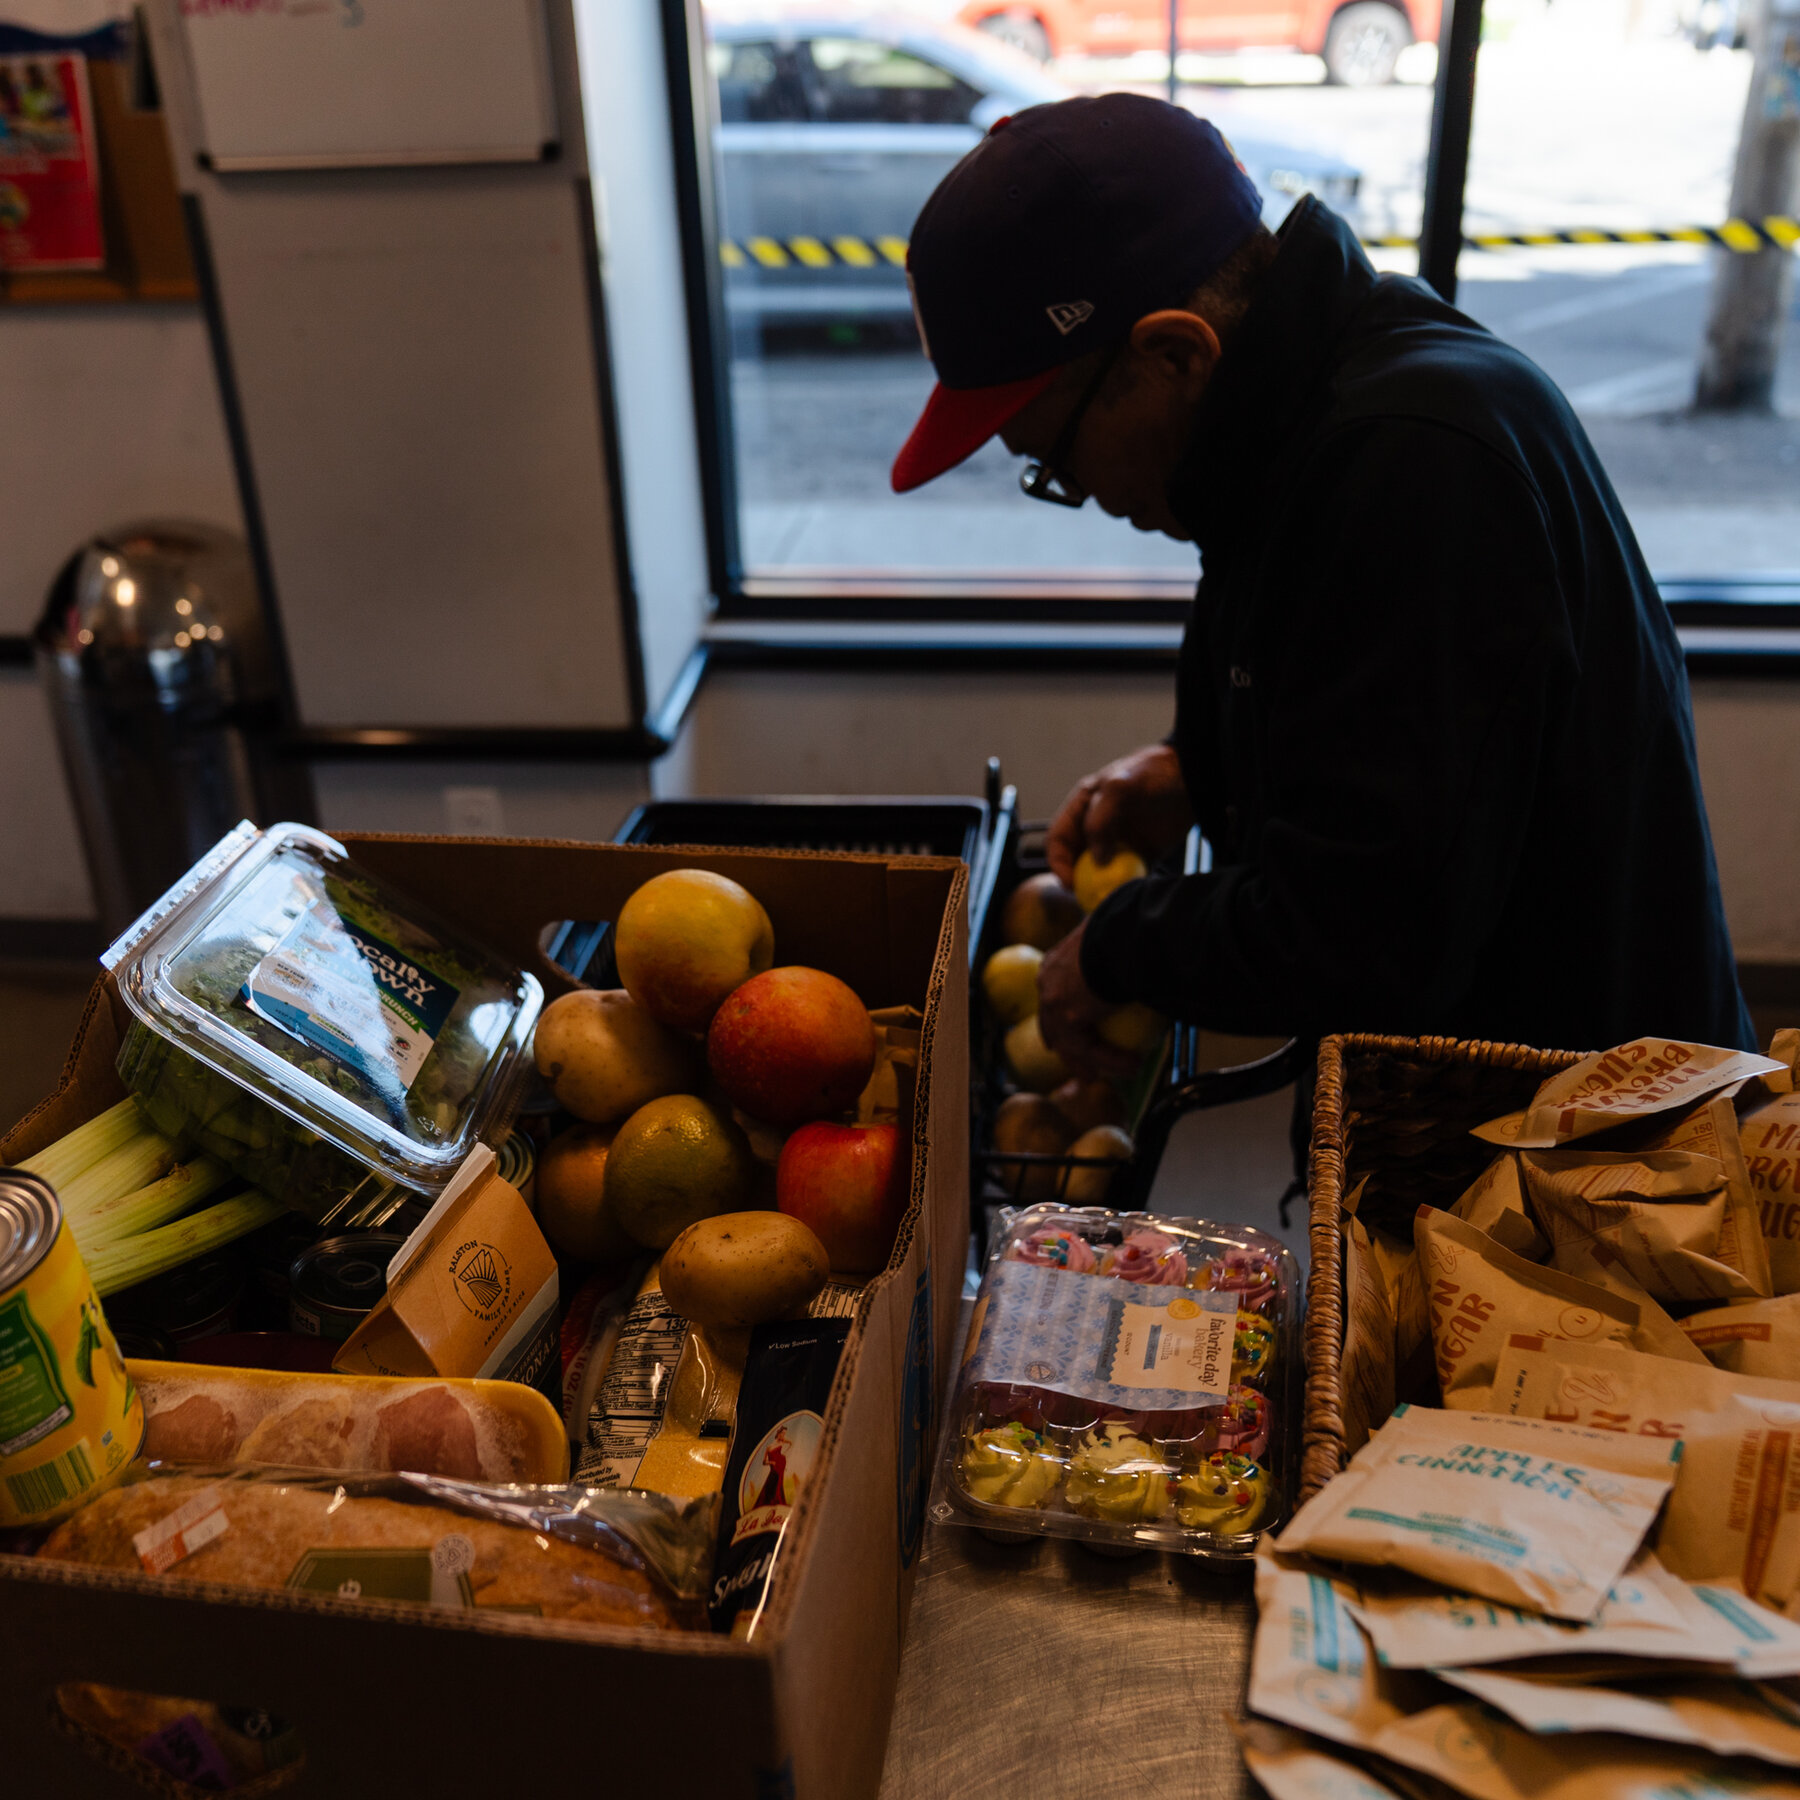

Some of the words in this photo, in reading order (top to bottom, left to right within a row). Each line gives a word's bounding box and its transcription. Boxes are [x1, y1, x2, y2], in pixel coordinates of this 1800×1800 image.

[1692, 1121, 1713, 1135] 150
[1760, 1122, 1800, 1151] MA
[449, 1240, 479, 1274] RALSTON
[473, 1306, 503, 1322] FAMILY
[666, 1319, 687, 1330] 130
[775, 1341, 790, 1350] Low
[791, 1337, 818, 1348] Sodium
[1160, 1331, 1174, 1361] vanilla
[1186, 1327, 1205, 1369] bakery
[1207, 1317, 1227, 1363] favorite
[1438, 1293, 1497, 1387] UGAR
[566, 1371, 582, 1392] OZ
[1197, 1362, 1218, 1387] day
[1396, 1452, 1572, 1501] CINNAMON
[1454, 1443, 1588, 1485] APPLES
